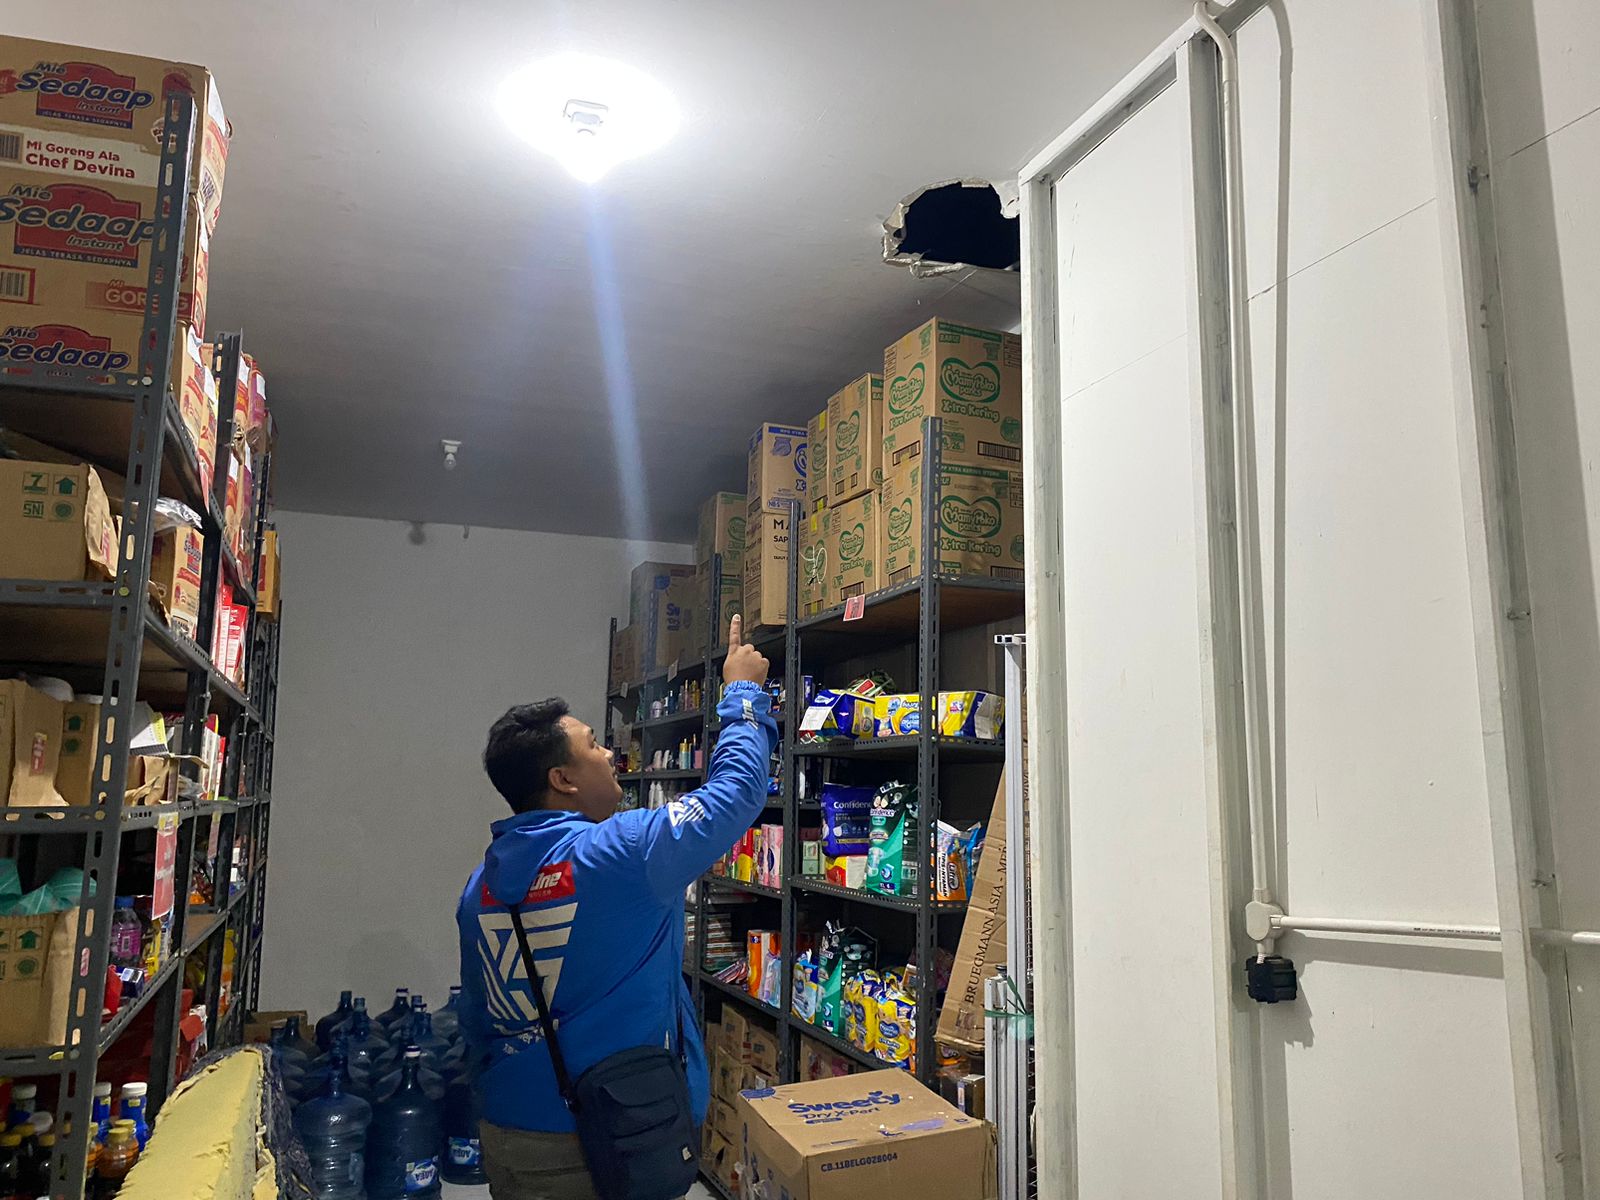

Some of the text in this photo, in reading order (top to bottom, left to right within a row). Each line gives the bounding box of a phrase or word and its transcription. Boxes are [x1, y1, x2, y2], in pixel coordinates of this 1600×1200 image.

[35, 61, 67, 75] Mie
[16, 72, 154, 111] Sedaap
[76, 101, 122, 115] Instant
[26, 140, 120, 161] Mi Goreng Ala
[26, 153, 135, 179] Chef Devina
[11, 184, 53, 201] Mie
[66, 235, 124, 251] Instant
[105, 287, 189, 310] GORG
[4, 326, 39, 340] Mie
[23, 503, 44, 516] SNI
[773, 535, 788, 543] SAP
[833, 800, 871, 809] Confiden
[964, 916, 995, 1005] BRUEGMANN
[988, 884, 1004, 915] ASIA
[787, 1091, 901, 1113] Sweety
